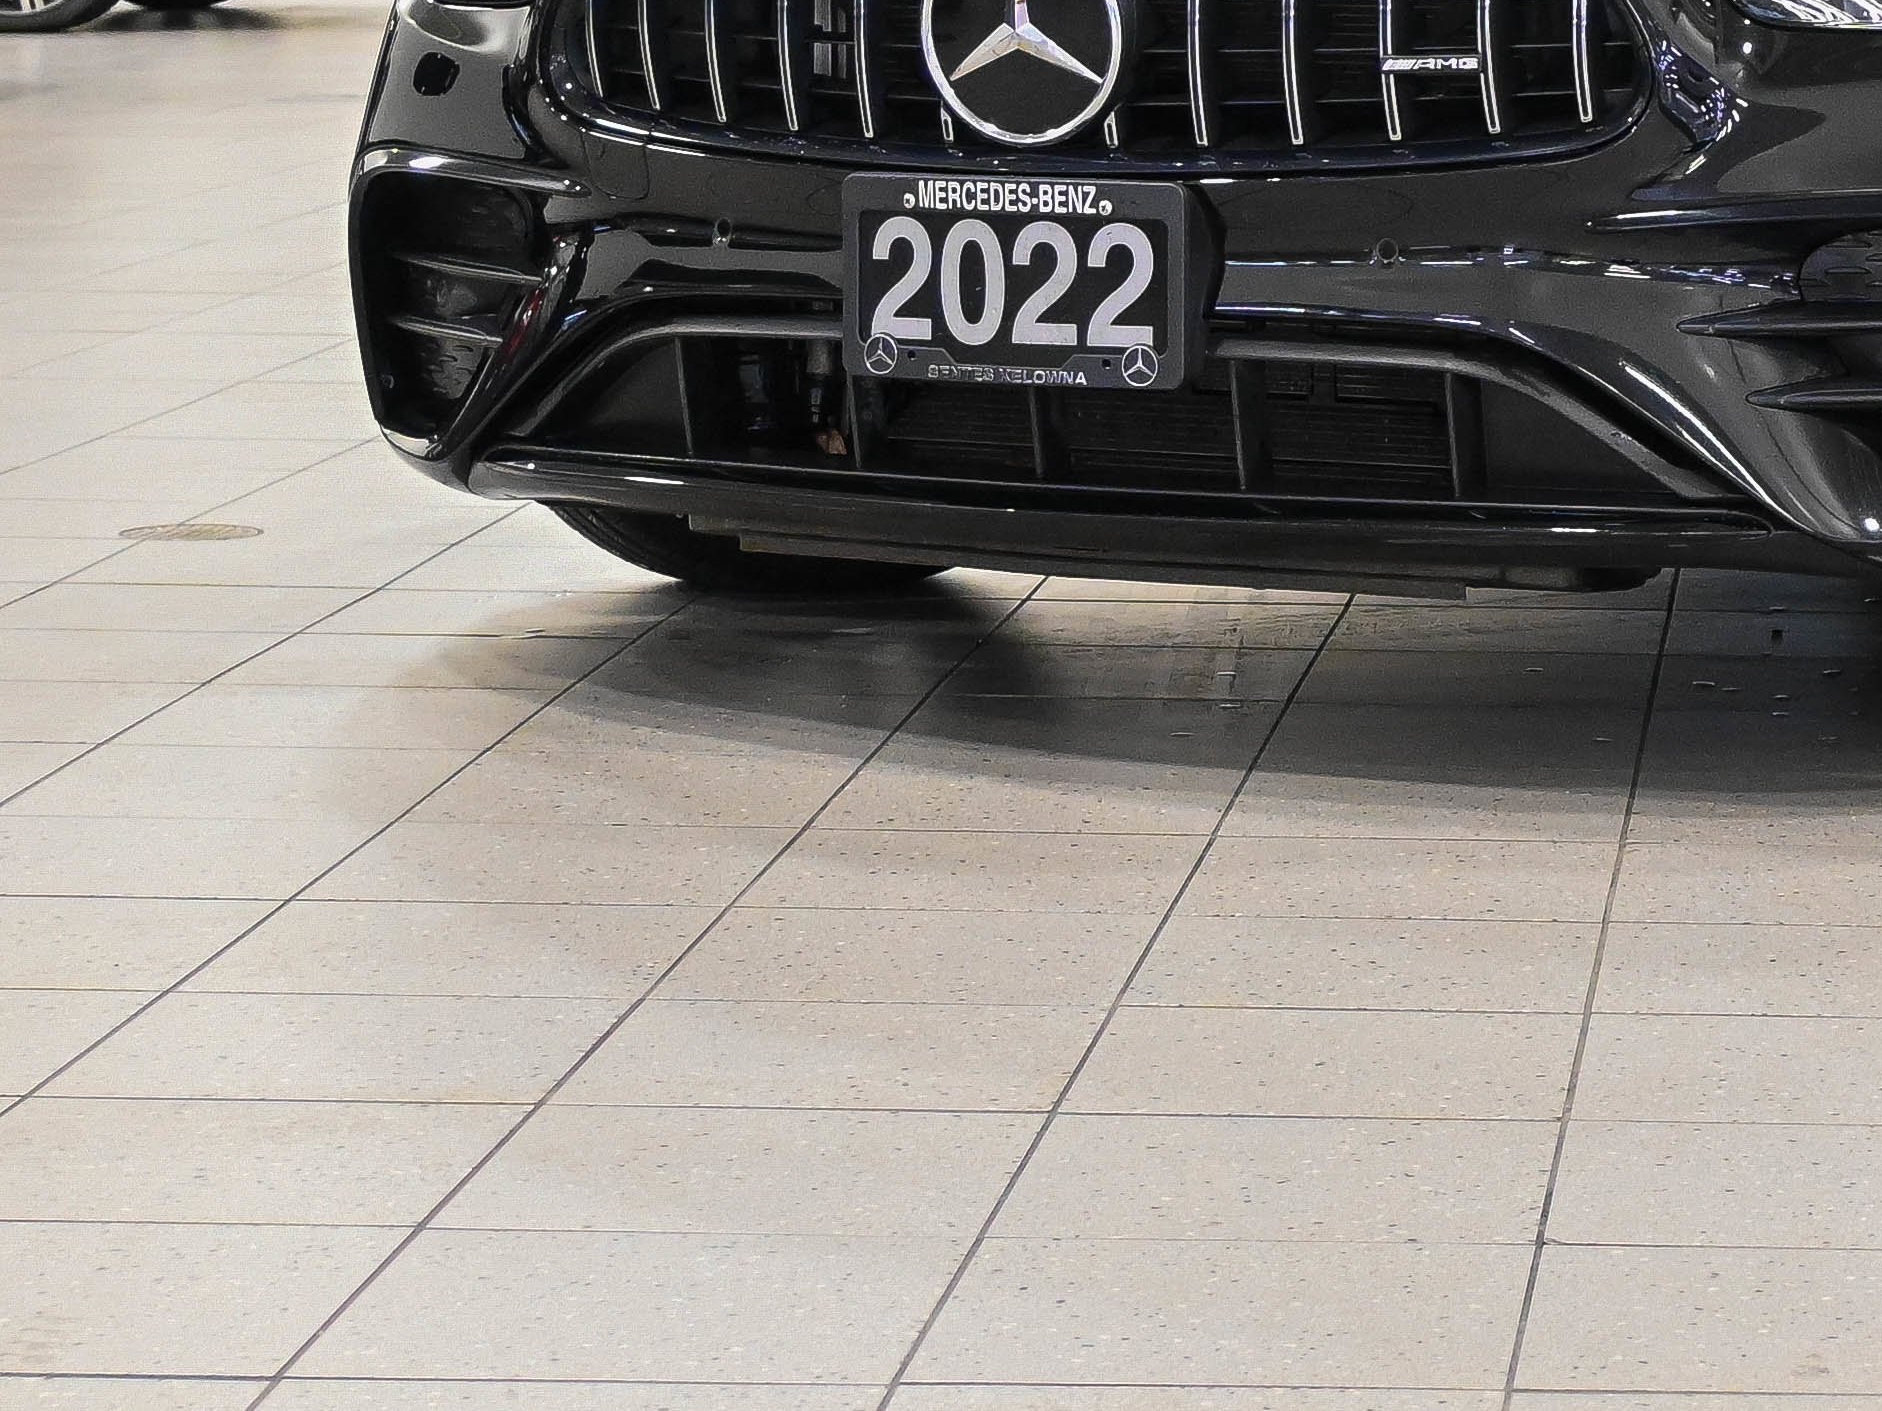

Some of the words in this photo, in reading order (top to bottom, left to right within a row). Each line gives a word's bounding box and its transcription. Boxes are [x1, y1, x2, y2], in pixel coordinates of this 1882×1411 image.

[1410, 58, 1479, 70] AMG
[918, 180, 1097, 214] MERCEDES-BENZ
[871, 216, 1154, 347] 2022
